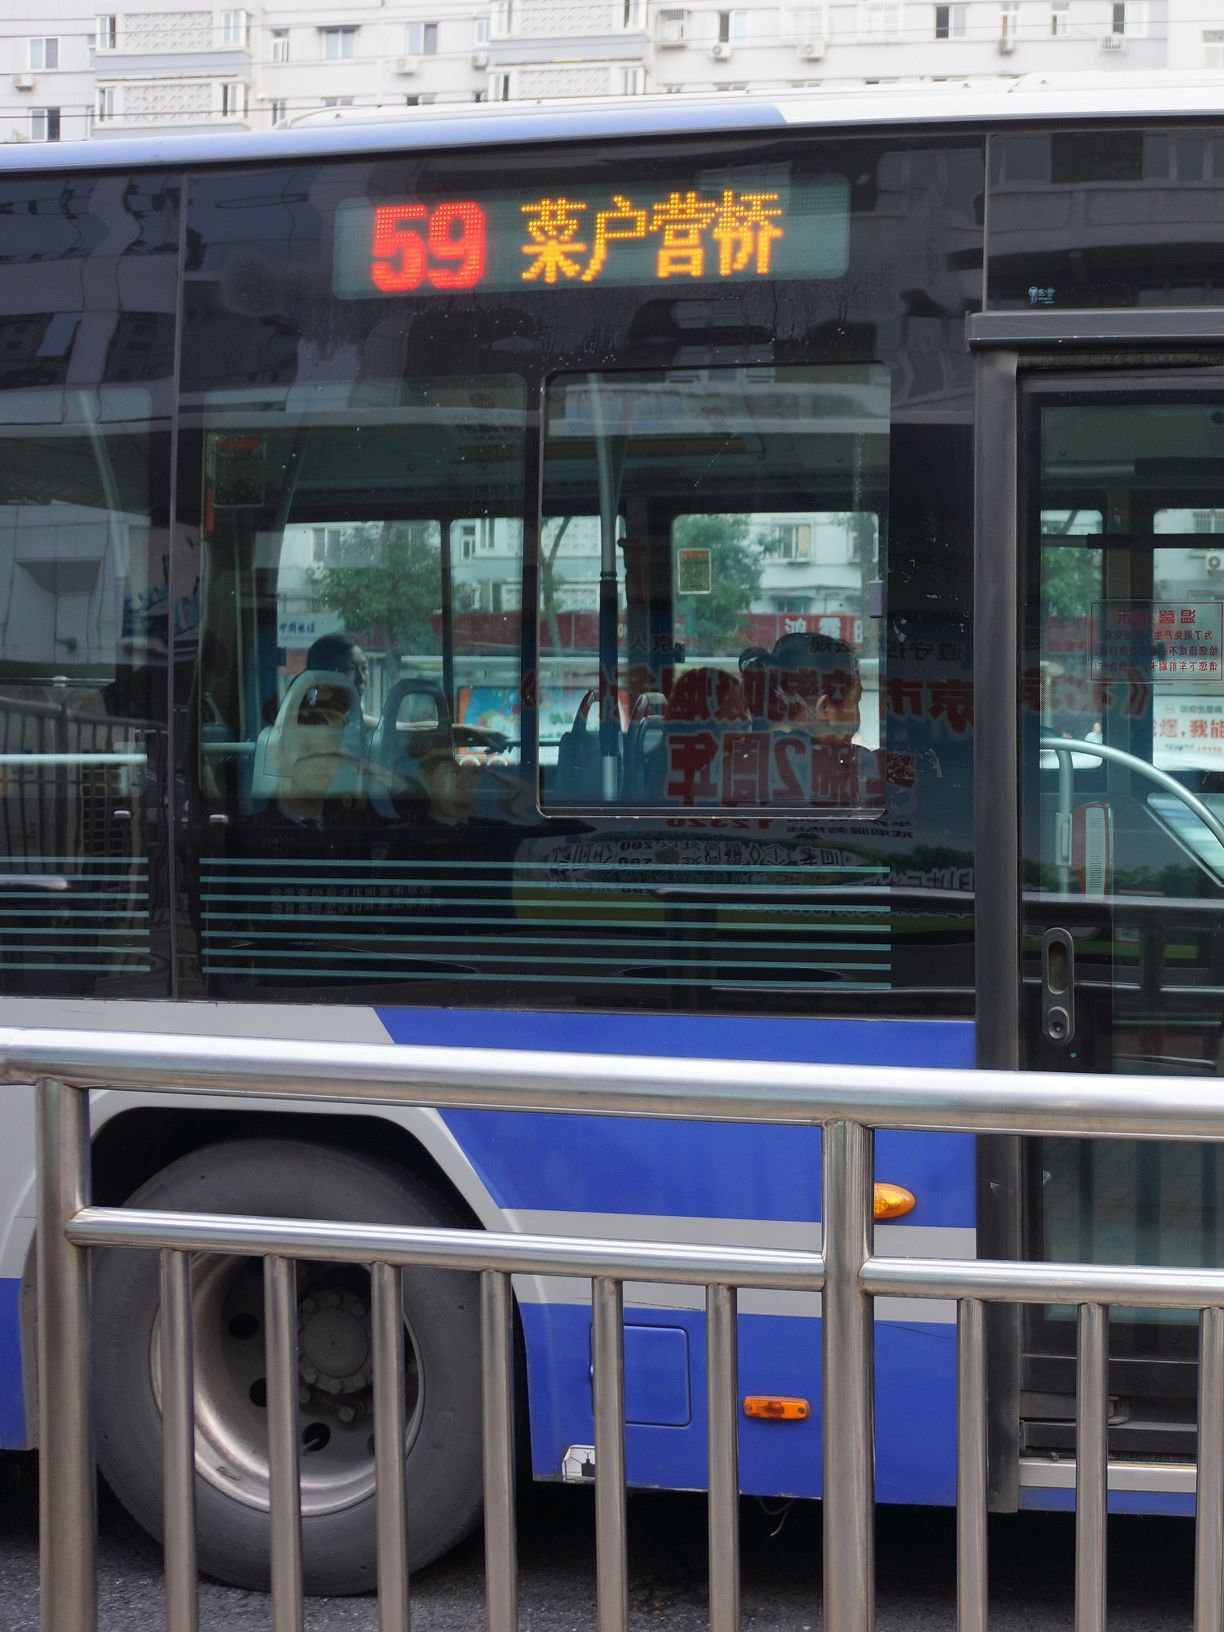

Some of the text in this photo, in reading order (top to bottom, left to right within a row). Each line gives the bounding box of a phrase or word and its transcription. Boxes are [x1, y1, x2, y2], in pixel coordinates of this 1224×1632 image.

[371, 202, 487, 293] 59
[520, 190, 783, 284] 菜户营桥
